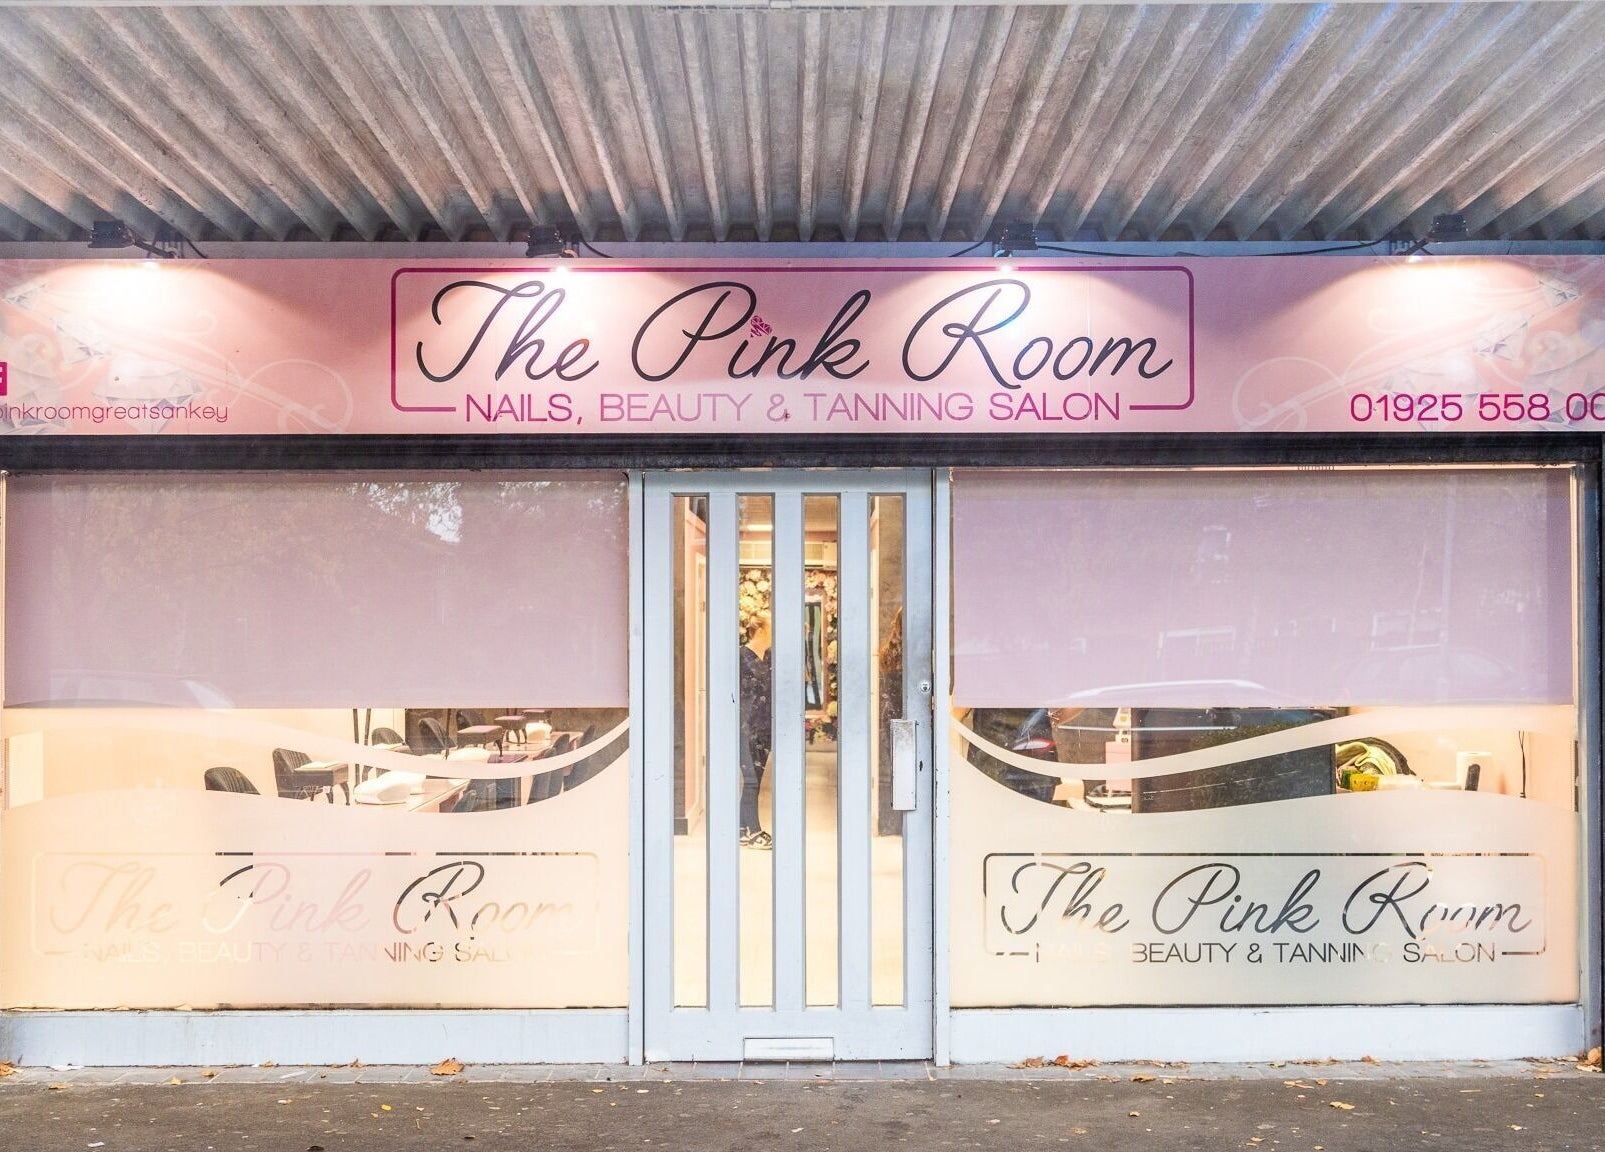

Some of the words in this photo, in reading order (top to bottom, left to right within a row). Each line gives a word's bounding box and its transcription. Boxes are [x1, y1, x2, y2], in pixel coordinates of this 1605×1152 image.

[416, 280, 600, 383] The
[631, 280, 871, 383] Pink
[902, 278, 1174, 390] Room
[0, 402, 228, 424] inkroomgreatsankey
[465, 392, 583, 425] NAILS,
[600, 392, 753, 422] BEAUTY
[766, 392, 790, 422] &
[804, 392, 974, 421] TANNING
[988, 391, 1121, 421] SALON
[1350, 393, 1464, 422] 01925
[1478, 393, 1551, 422] 558
[201, 861, 370, 934] Pink
[1001, 861, 1130, 935] The
[1152, 862, 1320, 935] Pink
[1342, 861, 1532, 940] Room
[178, 941, 287, 963] BEAUTY
[1132, 942, 1238, 963] BEAUTY
[1246, 942, 1263, 963] &
[1402, 941, 1496, 963] SALON
